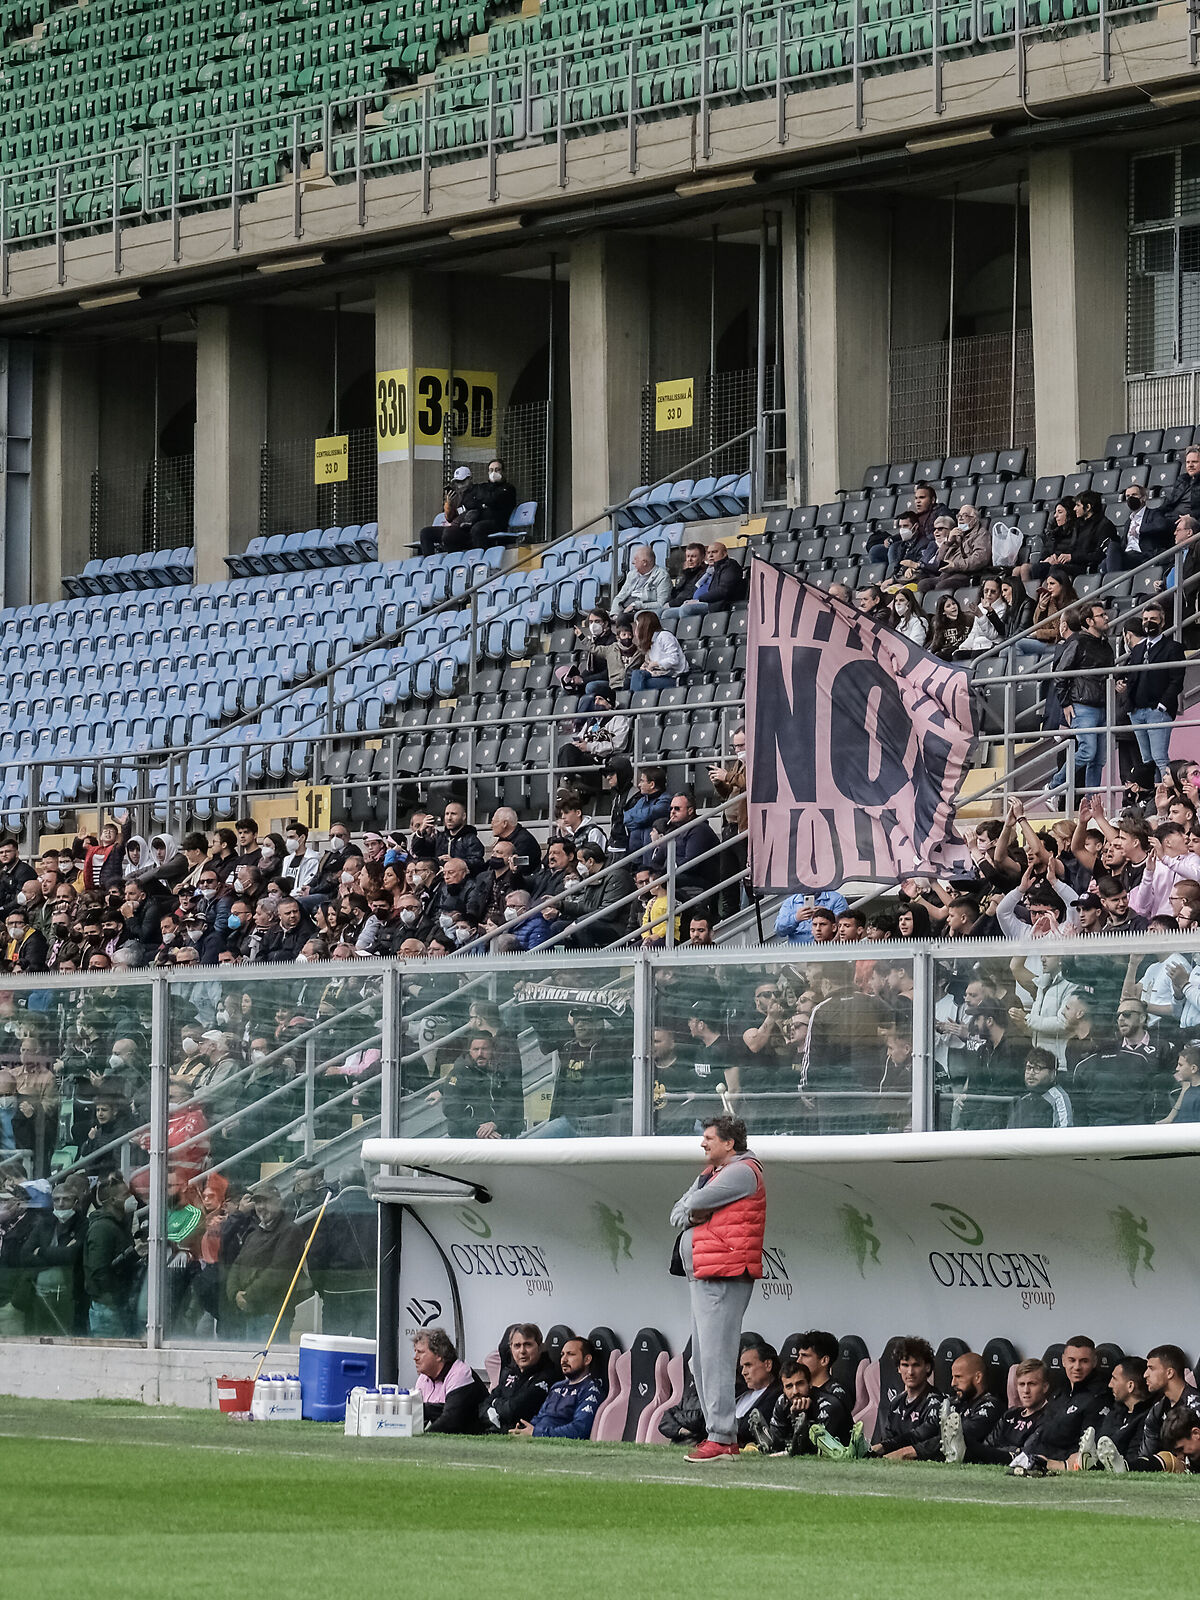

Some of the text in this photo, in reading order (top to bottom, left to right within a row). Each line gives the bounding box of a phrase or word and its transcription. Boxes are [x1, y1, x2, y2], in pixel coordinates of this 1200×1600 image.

[687, 387, 693, 399] A
[377, 377, 407, 438] 33D
[418, 375, 494, 438] 33D
[667, 407, 682, 420] 33 D
[325, 462, 339, 475] 33 D
[305, 789, 323, 830] 1F
[450, 1243, 550, 1278] OXYGEN
[929, 1251, 1053, 1289] OXYGEN
[526, 1278, 554, 1296] group
[761, 1281, 793, 1300] group
[1021, 1290, 1055, 1310] group
